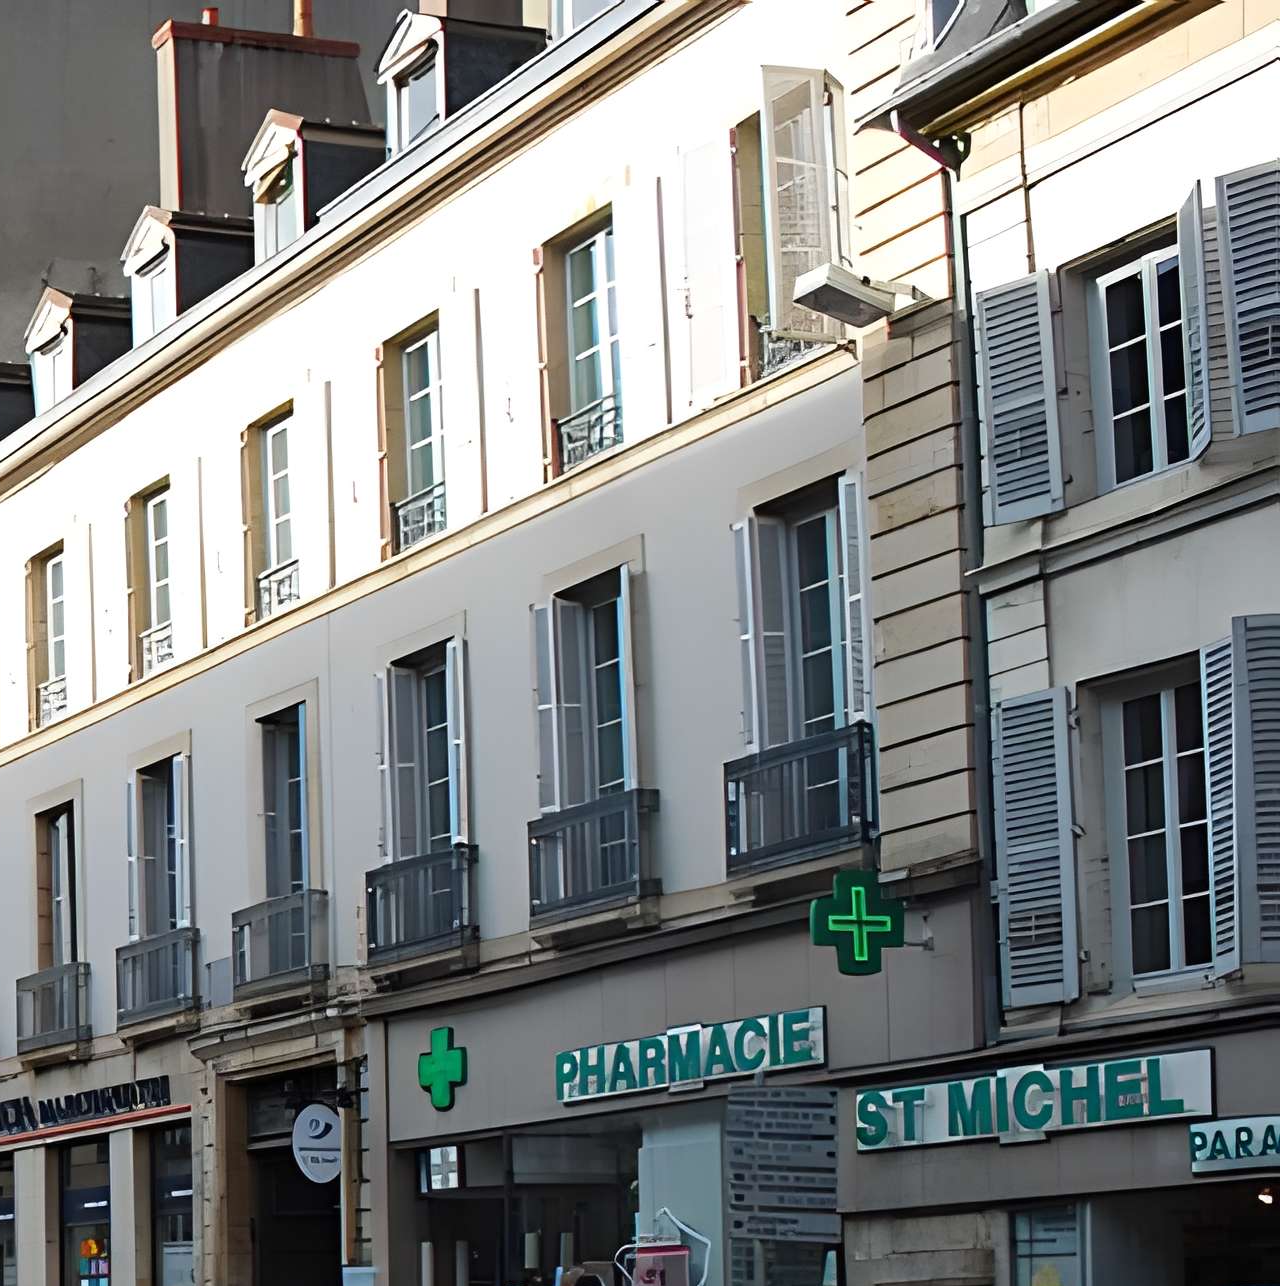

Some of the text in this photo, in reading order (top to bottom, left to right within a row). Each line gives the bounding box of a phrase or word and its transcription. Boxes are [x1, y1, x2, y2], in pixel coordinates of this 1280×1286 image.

[555, 1008, 812, 1102] PHARMACIE
[856, 1057, 1185, 1146] ST MICHEL
